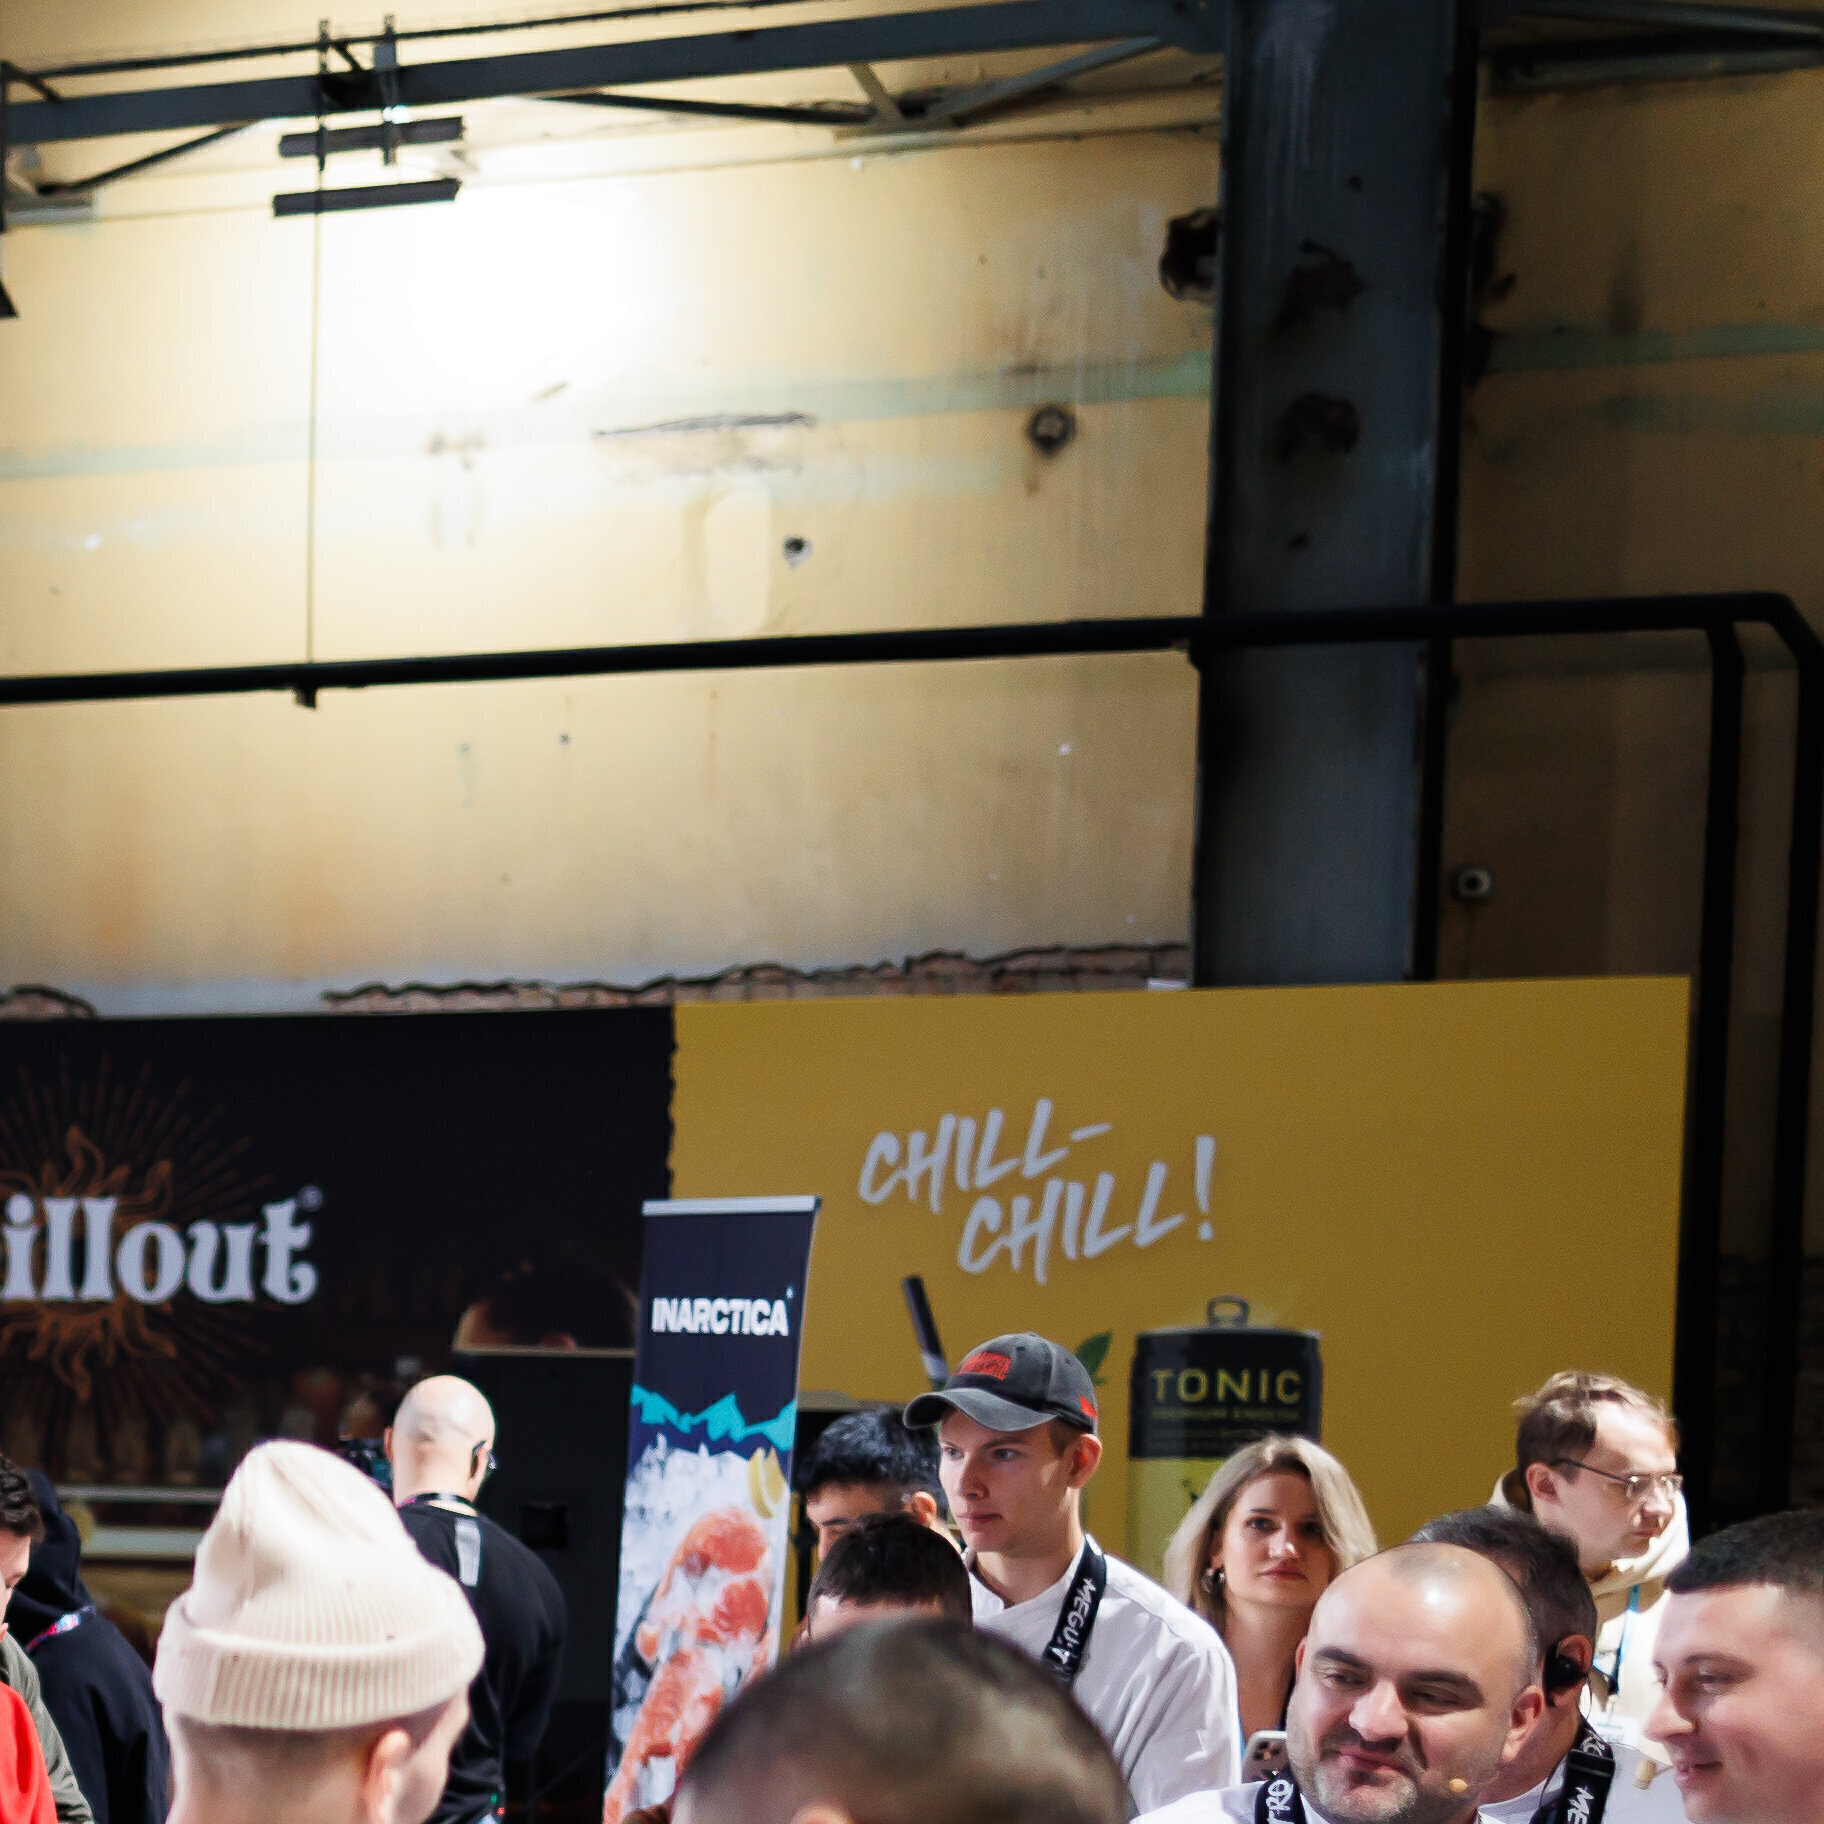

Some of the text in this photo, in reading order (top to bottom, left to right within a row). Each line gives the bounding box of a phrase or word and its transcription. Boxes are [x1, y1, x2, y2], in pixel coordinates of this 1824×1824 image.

[858, 1099, 1114, 1214] CHILL-
[957, 1134, 1216, 1285] CHILL!
[652, 1297, 790, 1337] INARCTICA
[1151, 1369, 1302, 1404] TONIC
